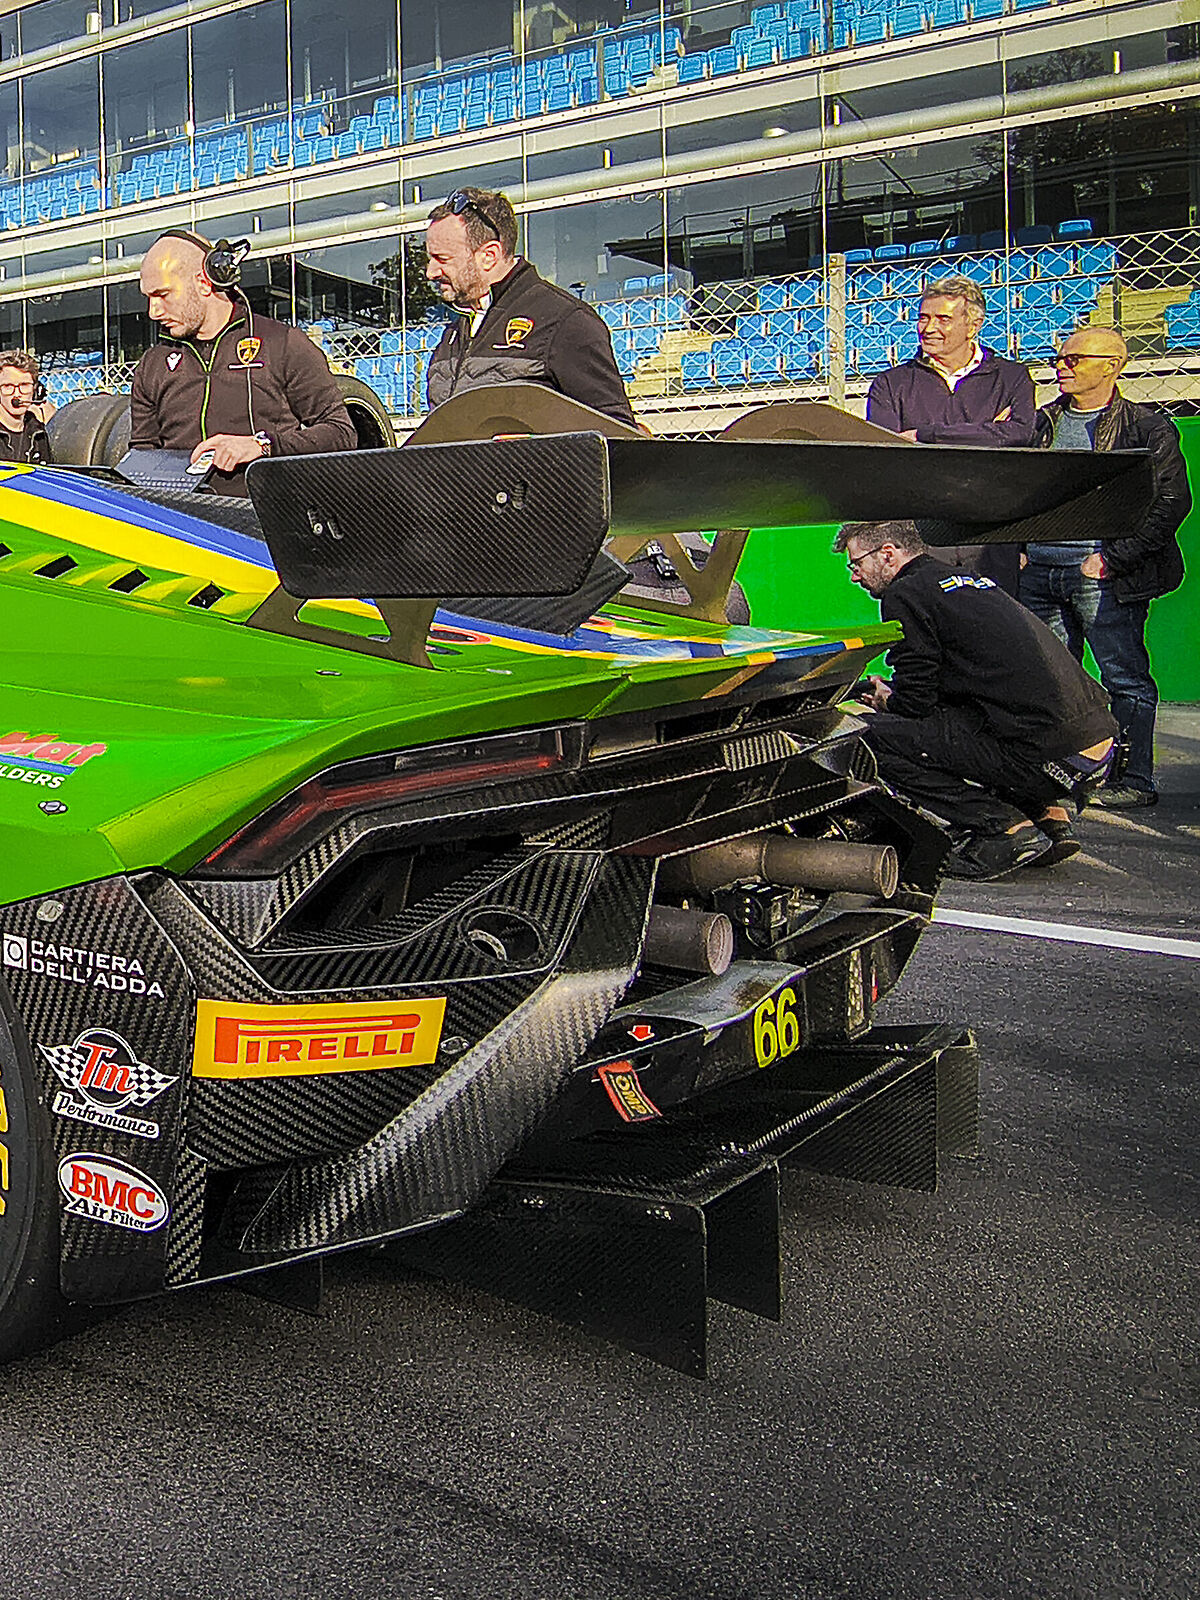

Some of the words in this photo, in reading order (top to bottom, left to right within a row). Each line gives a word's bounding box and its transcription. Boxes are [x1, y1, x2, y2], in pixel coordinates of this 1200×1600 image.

[31, 940, 145, 976] CARTIERA
[31, 958, 165, 998] DELL'ADDA
[214, 1013, 422, 1065] PIRELLI
[754, 988, 799, 1069] 66
[57, 1094, 157, 1136] Performance
[615, 1075, 649, 1116] OMP
[69, 1164, 155, 1219] BMC
[69, 1198, 108, 1219] Air
[111, 1209, 146, 1230] Filter
